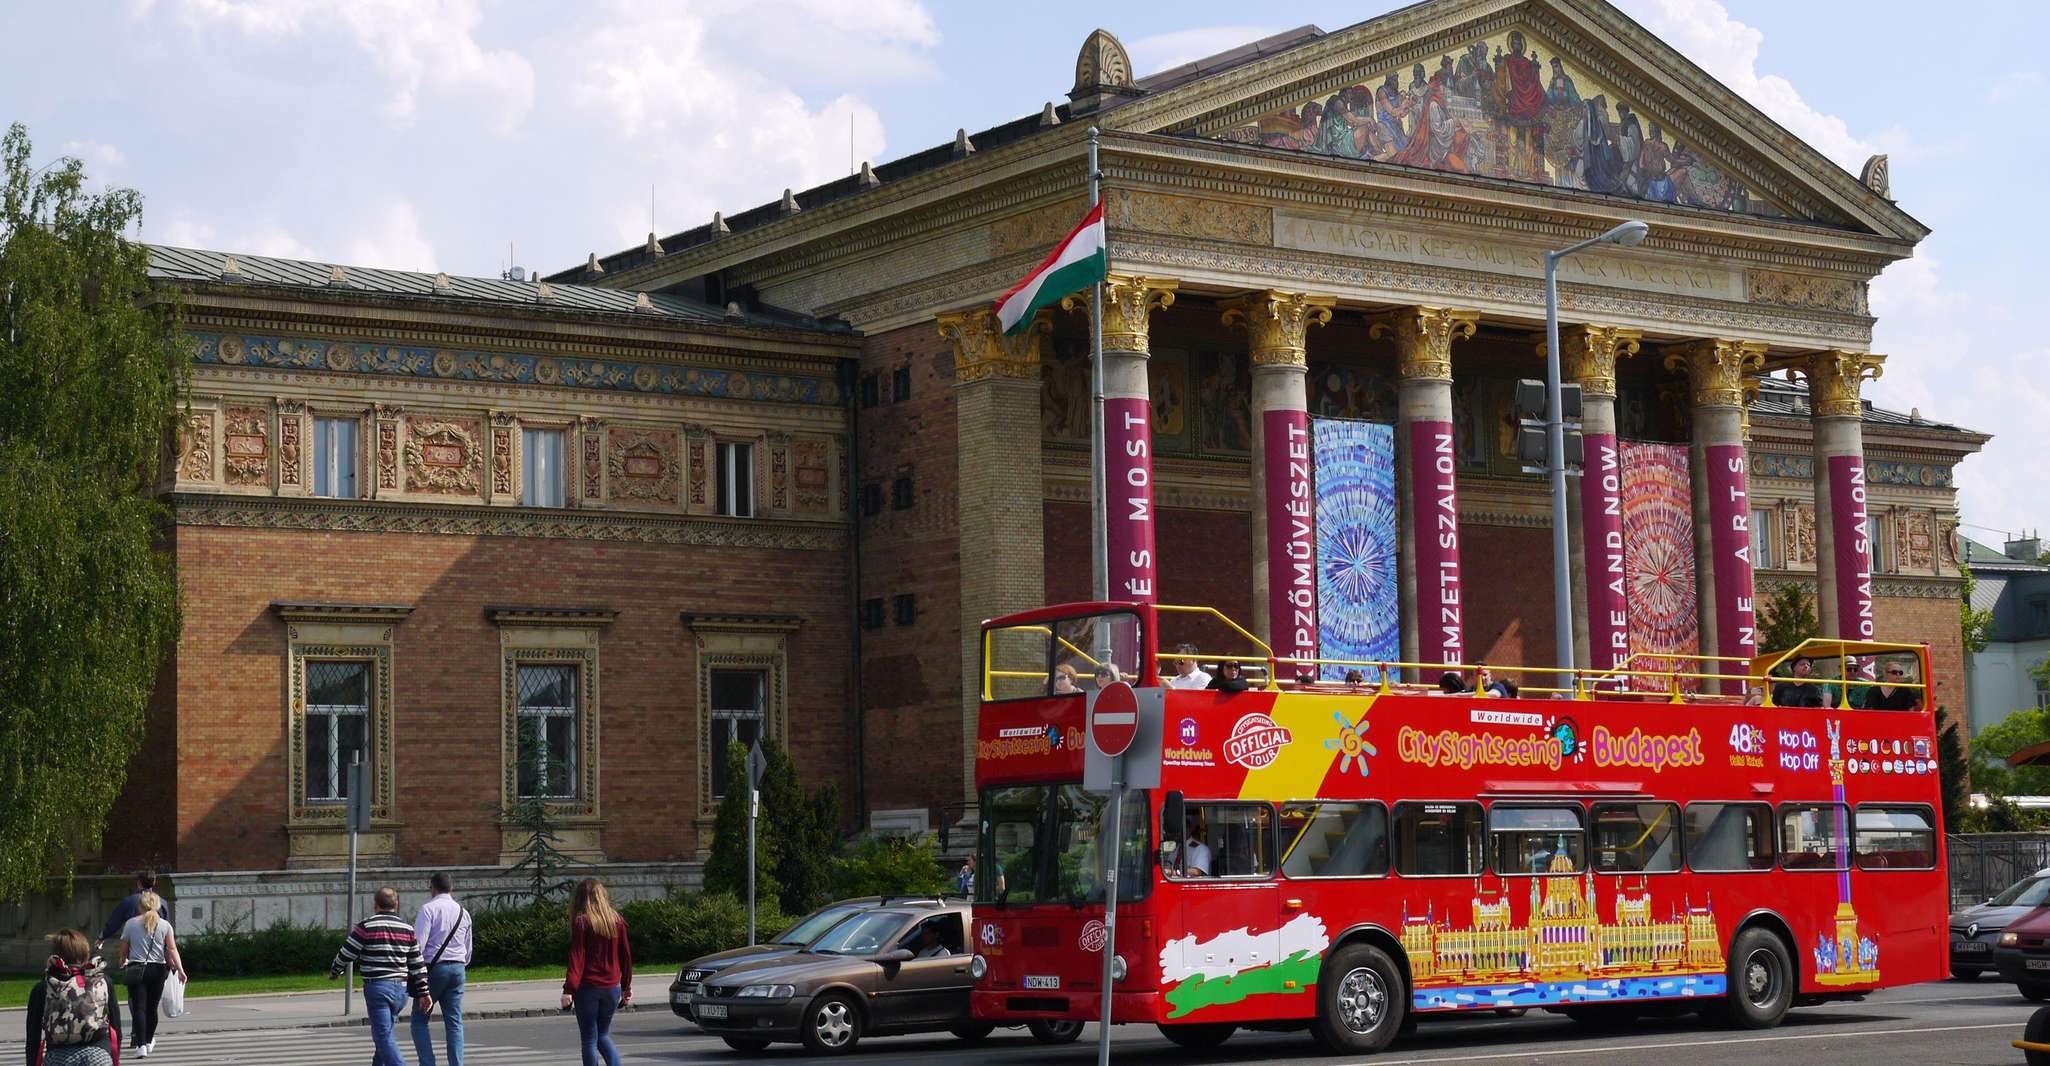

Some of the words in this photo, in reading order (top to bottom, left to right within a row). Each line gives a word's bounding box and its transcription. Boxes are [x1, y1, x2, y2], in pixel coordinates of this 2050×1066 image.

[1304, 223, 1317, 243] A
[1327, 225, 1409, 254] MAGYAR
[1124, 411, 1151, 521] MOST
[1600, 445, 1622, 517] NOW
[1434, 433, 1458, 551] SZALON
[1727, 456, 1751, 565] ARTS
[1848, 466, 1870, 554] SALON
[1125, 550, 1153, 596] ÉS
[1604, 530, 1626, 597] AND
[1439, 561, 1462, 677] EMZETI
[1610, 610, 1630, 692] HERE
[1477, 711, 1541, 725] Worldwide
[1729, 723, 1752, 753] 48
[1779, 730, 1800, 749] Hop
[1802, 730, 1817, 748] On
[1231, 729, 1290, 758] OFFICIAL
[1249, 748, 1277, 767] TOUR
[1398, 725, 1562, 771] CitySightseeing
[1593, 725, 1705, 773] Budapest
[1780, 752, 1801, 771] Hop
[1803, 752, 1821, 770] Off
[981, 924, 996, 945] 48
